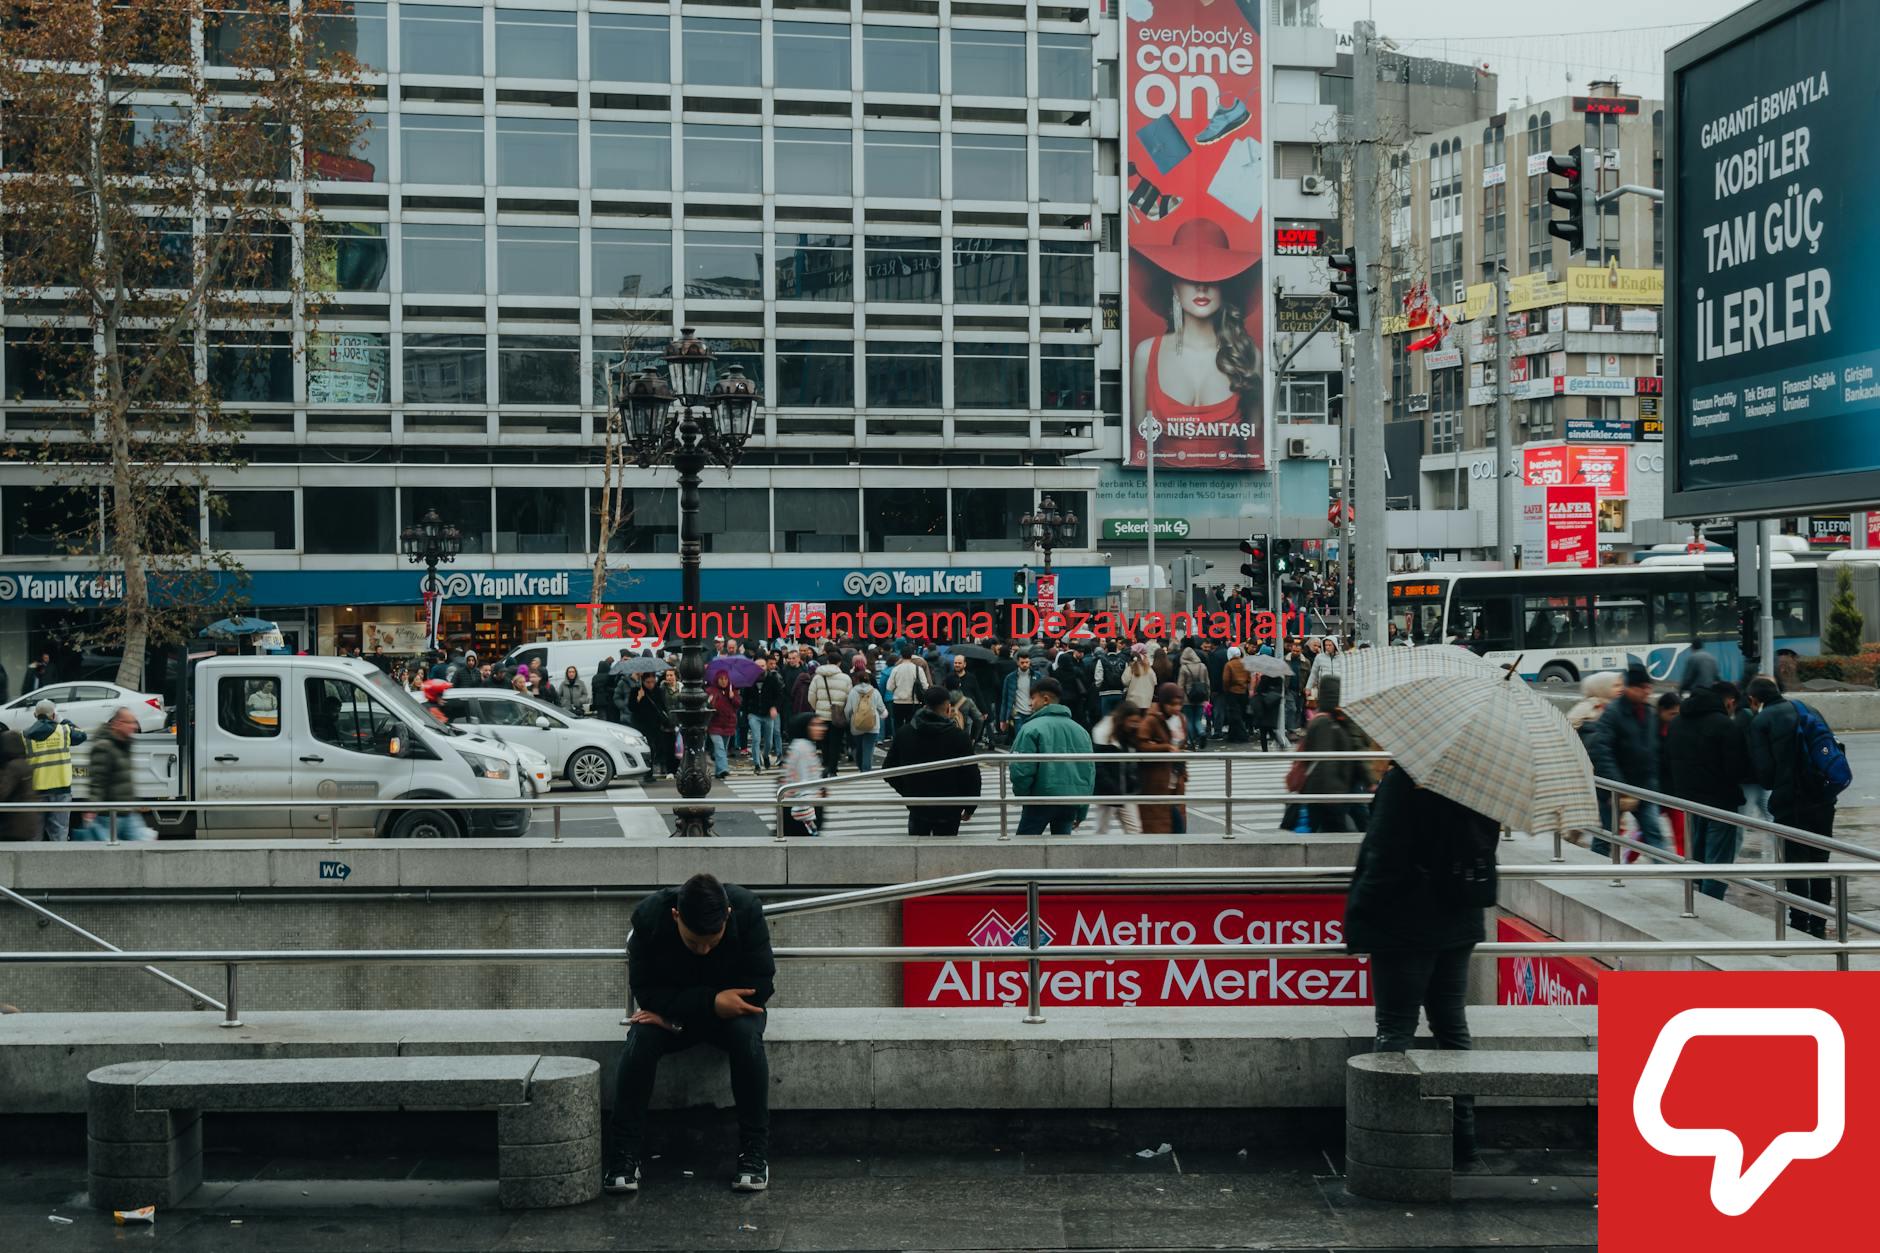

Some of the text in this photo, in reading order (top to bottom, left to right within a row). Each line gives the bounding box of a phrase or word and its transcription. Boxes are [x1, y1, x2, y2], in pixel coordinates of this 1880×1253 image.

[1139, 24, 1253, 50] everybody's
[1137, 44, 1253, 75] come
[1135, 73, 1221, 120] on
[1701, 71, 1829, 149] GARANTİ BBVA'YLA
[1715, 126, 1811, 201] KOBİ'LER
[1277, 229, 1317, 242] LOVE
[1703, 182, 1824, 274] TAM GÜÇ
[1277, 243, 1317, 254] SHOP
[1575, 273, 1606, 289] CITI
[1697, 267, 1832, 363] İLERLER
[1569, 378, 1630, 391] gezinomi
[1744, 386, 1776, 402] Tek Ekran
[1782, 376, 1812, 395] Finansal
[1693, 397, 1714, 411] Uzman
[1167, 422, 1256, 441] NİŞANTAŞI
[1568, 429, 1632, 440] sineklikler.com
[1189, 479, 1208, 488] hem
[1528, 469, 1562, 485] %50
[1549, 502, 1592, 513] ZAFER
[471, 572, 569, 599] YapıKredi
[323, 863, 345, 877] WC
[1071, 909, 1197, 946] Metro
[1161, 956, 1369, 1002] Merkezi
